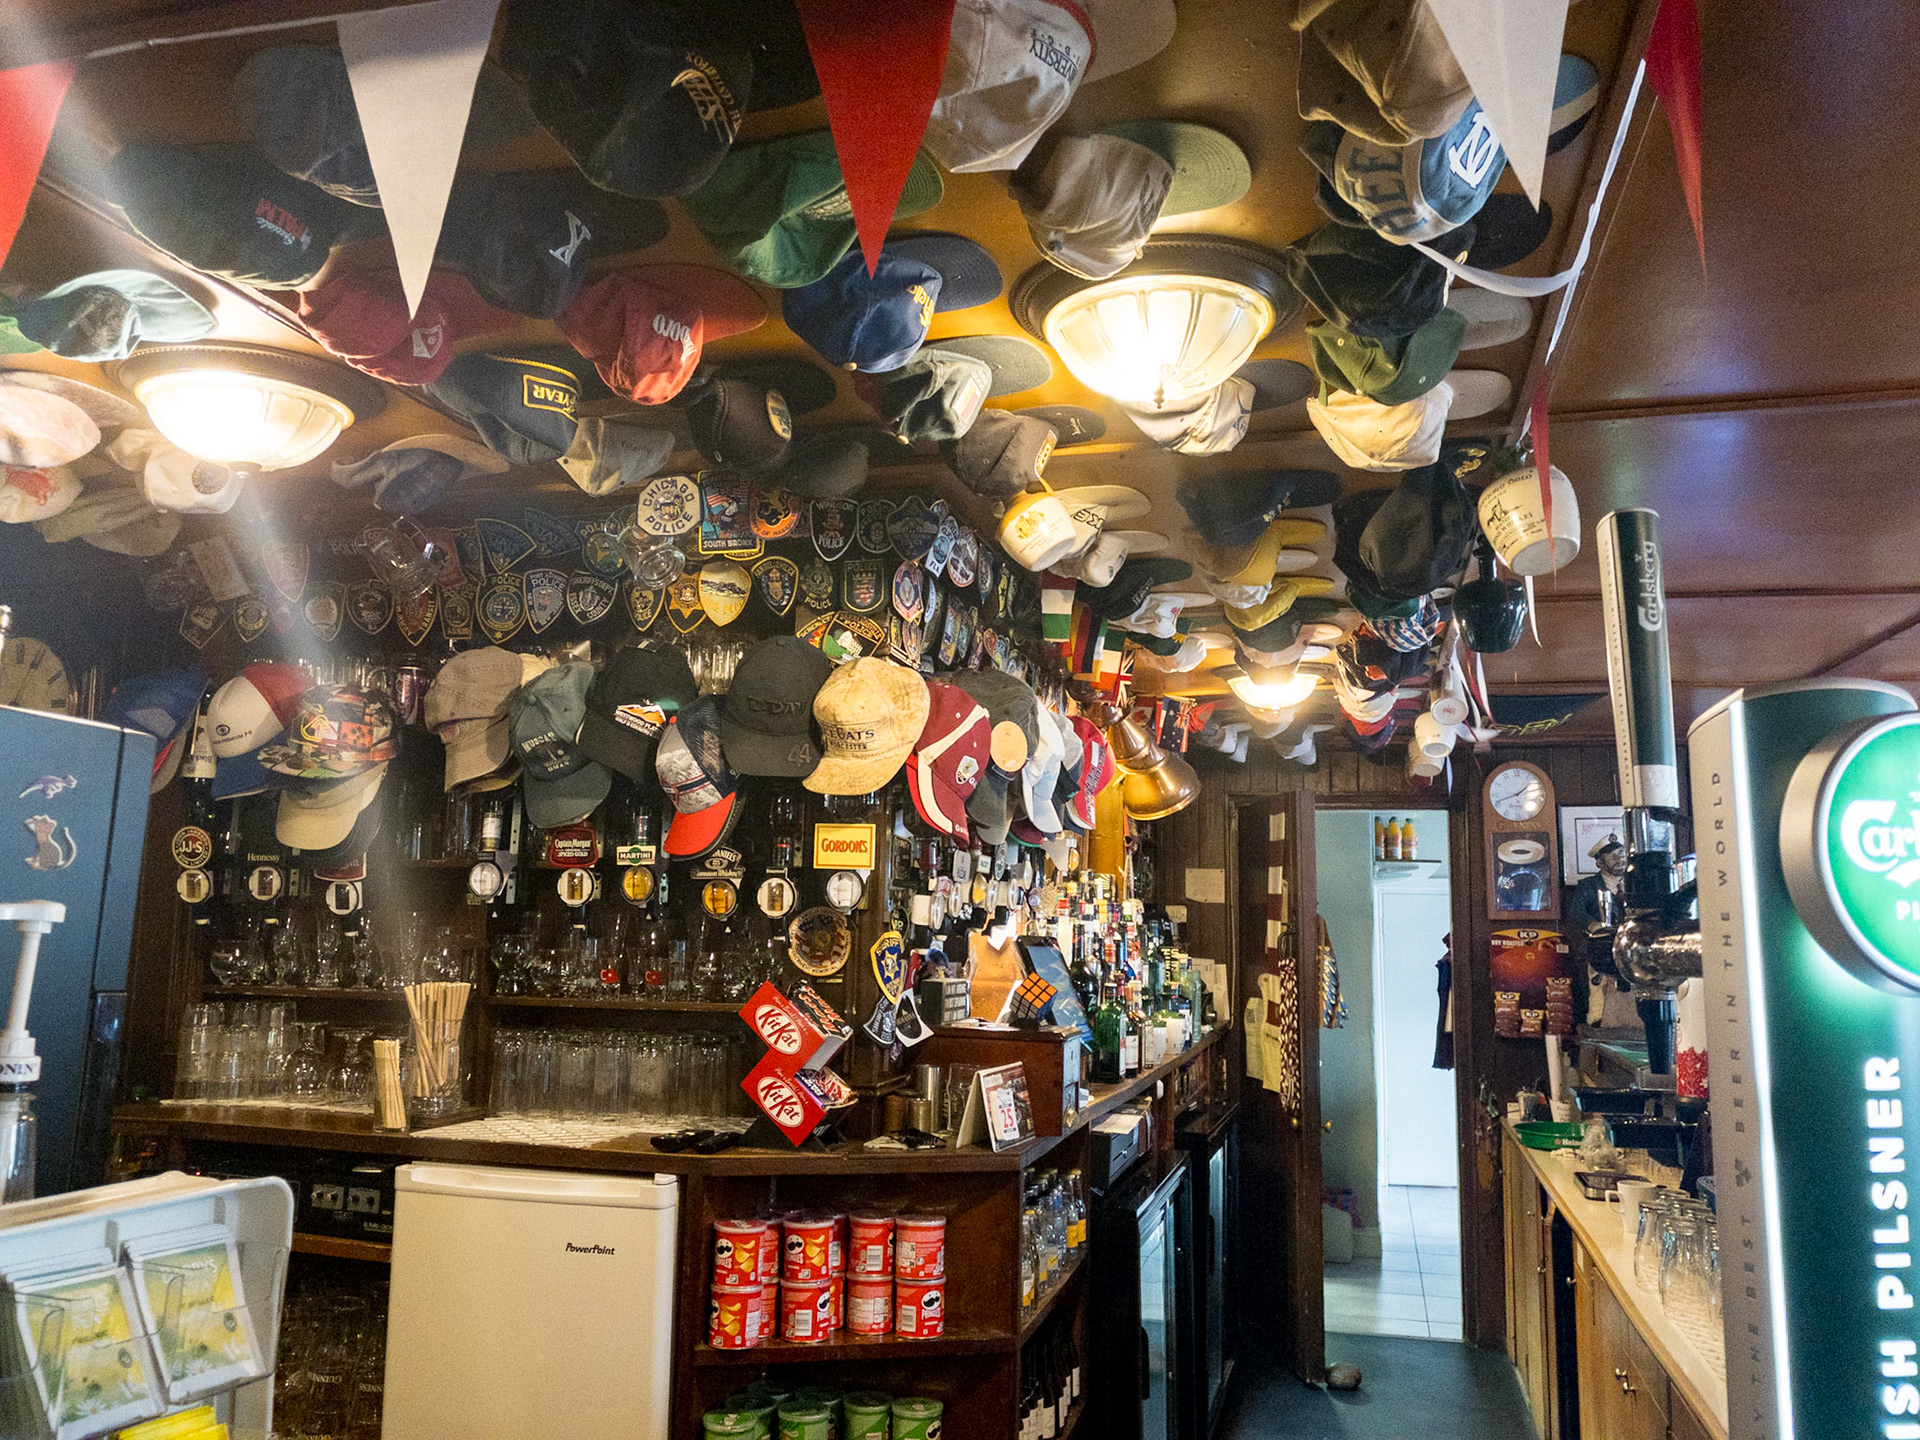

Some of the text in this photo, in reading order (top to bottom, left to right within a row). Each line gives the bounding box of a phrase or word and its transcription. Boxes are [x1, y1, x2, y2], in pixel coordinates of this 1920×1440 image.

[643, 478, 695, 507] CHICAGO
[645, 512, 693, 533] POLICE
[703, 539, 754, 548] SOUTH BRONX
[818, 535, 845, 549] POLICE
[492, 575, 521, 587] POLICE
[531, 578, 566, 593] POLICE
[1637, 541, 1663, 632] Carlsberg
[586, 597, 609, 619] COUNTY
[804, 597, 833, 610] POLICE
[521, 731, 556, 753] MUSCAT
[787, 743, 811, 764] 44
[547, 761, 570, 773] OMAN
[554, 838, 592, 849] Captain Morgan
[821, 837, 868, 853] GORDON'S
[247, 852, 281, 863] Hennessy
[619, 852, 651, 860] MARTINI
[1519, 931, 1538, 939] KP
[1712, 772, 1746, 1134] BEER IN THE WORLD
[1000, 1107, 1014, 1129] 25
[1864, 1055, 1915, 1311] PILSNER
[565, 1242, 616, 1255] PowerPoint
[1741, 1214, 1757, 1299] BEST
[1749, 1322, 1761, 1384] THE
